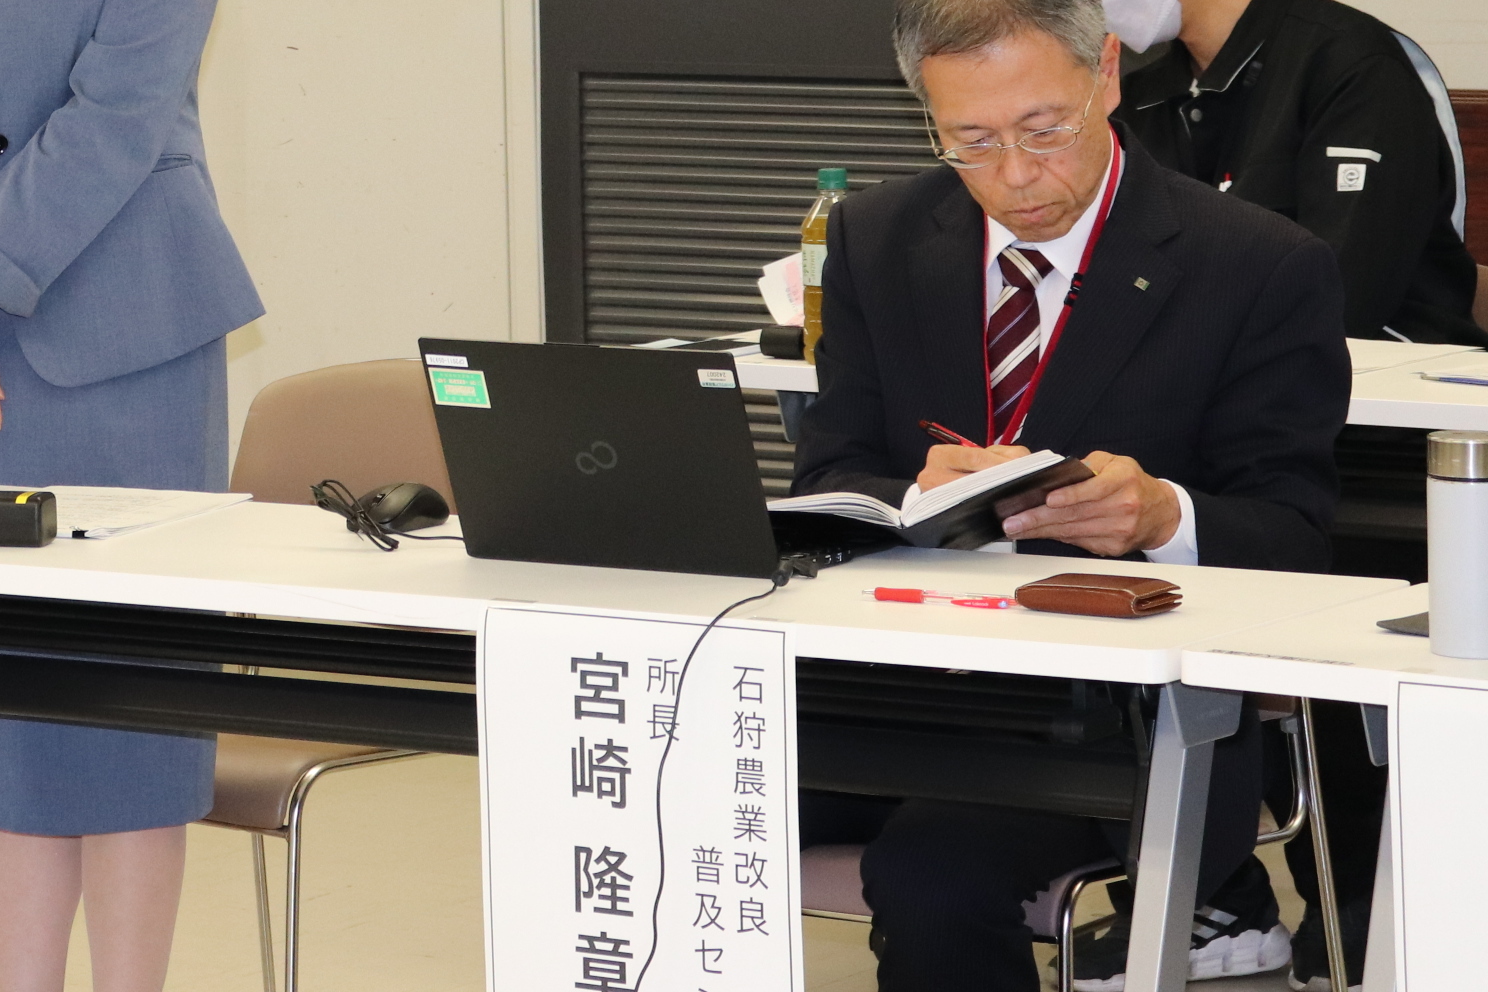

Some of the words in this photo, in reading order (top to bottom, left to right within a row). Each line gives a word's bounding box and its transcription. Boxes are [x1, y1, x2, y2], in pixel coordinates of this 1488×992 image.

[569, 651, 632, 810] 宮崎
[646, 657, 681, 743] 所長
[732, 665, 770, 937] 石狩農業改良
[691, 844, 726, 992] 普及セ
